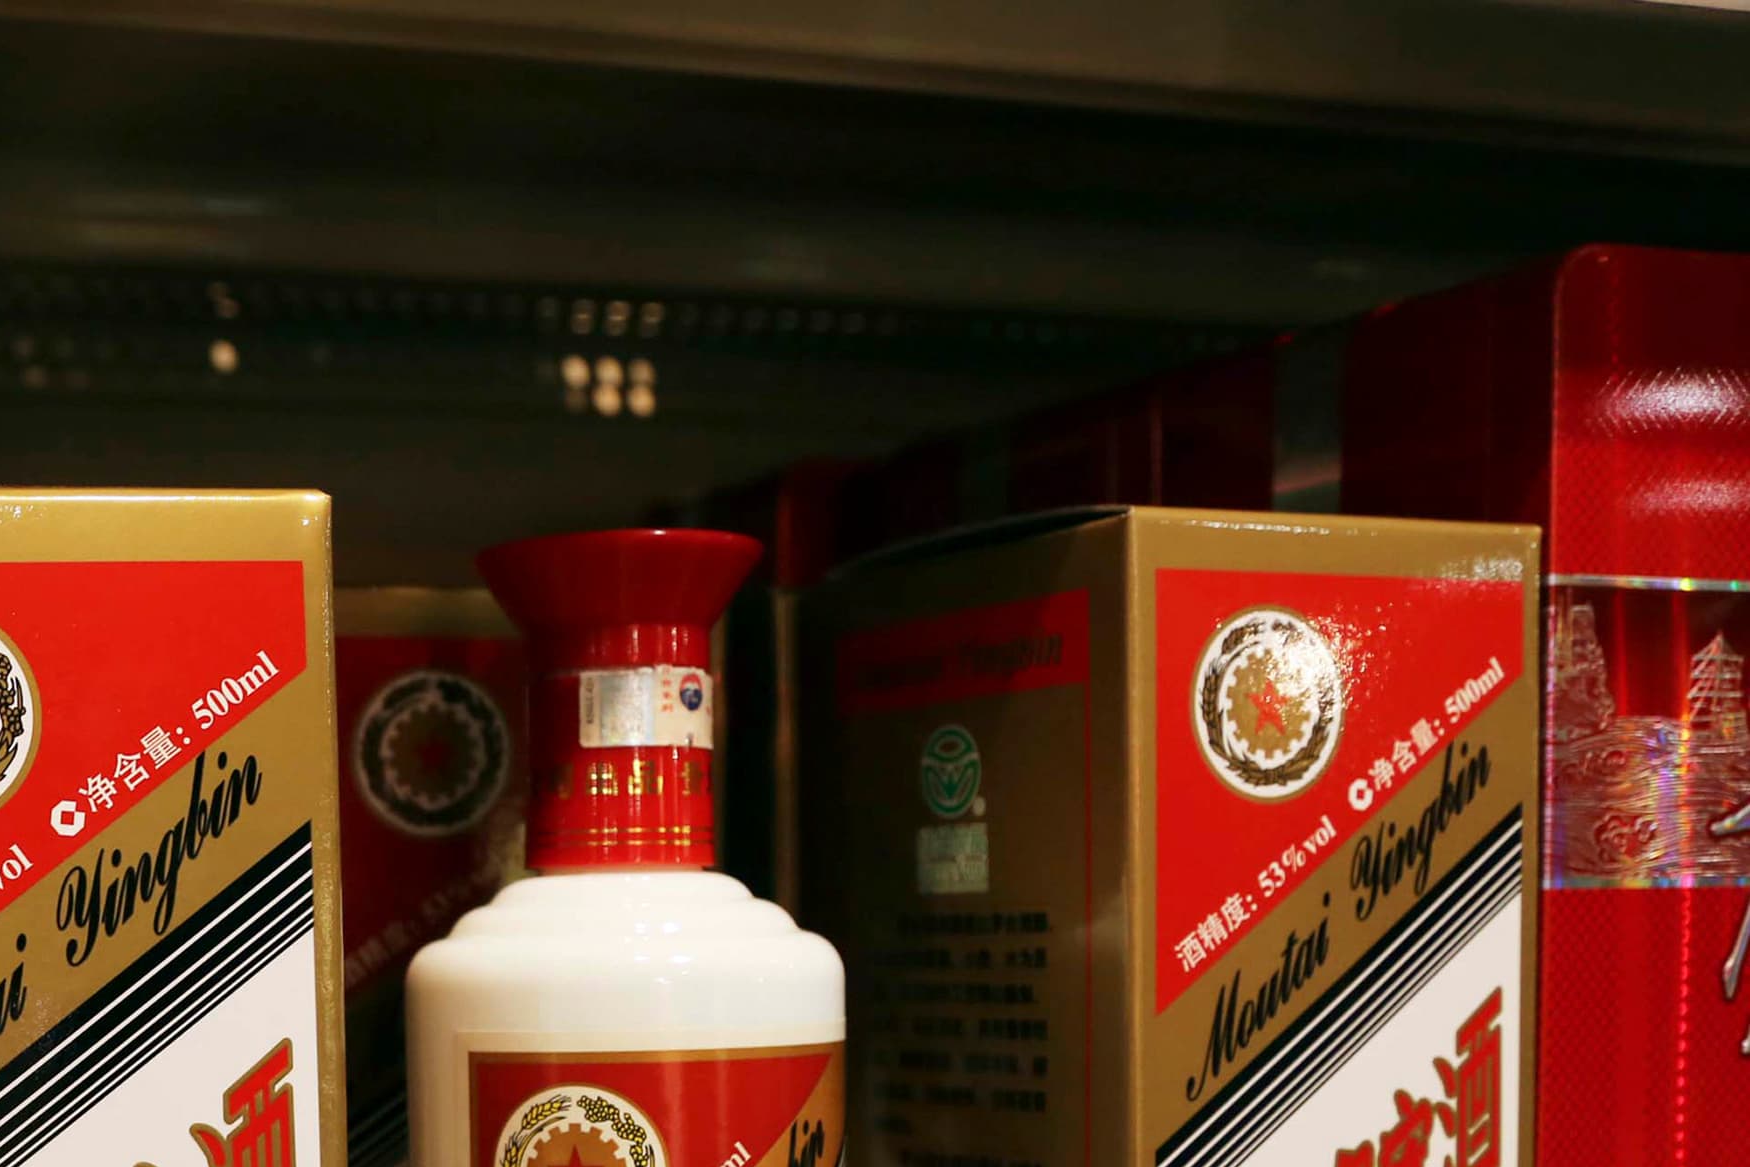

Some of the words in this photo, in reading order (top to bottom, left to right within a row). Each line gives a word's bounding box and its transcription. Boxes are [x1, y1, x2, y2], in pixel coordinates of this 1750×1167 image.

[191, 650, 279, 730] 500ml
[1444, 656, 1505, 725] 500ml
[56, 750, 263, 967] Yingbin
[1186, 892, 1330, 1101] Moutai
[1351, 741, 1492, 922] Yingbin
